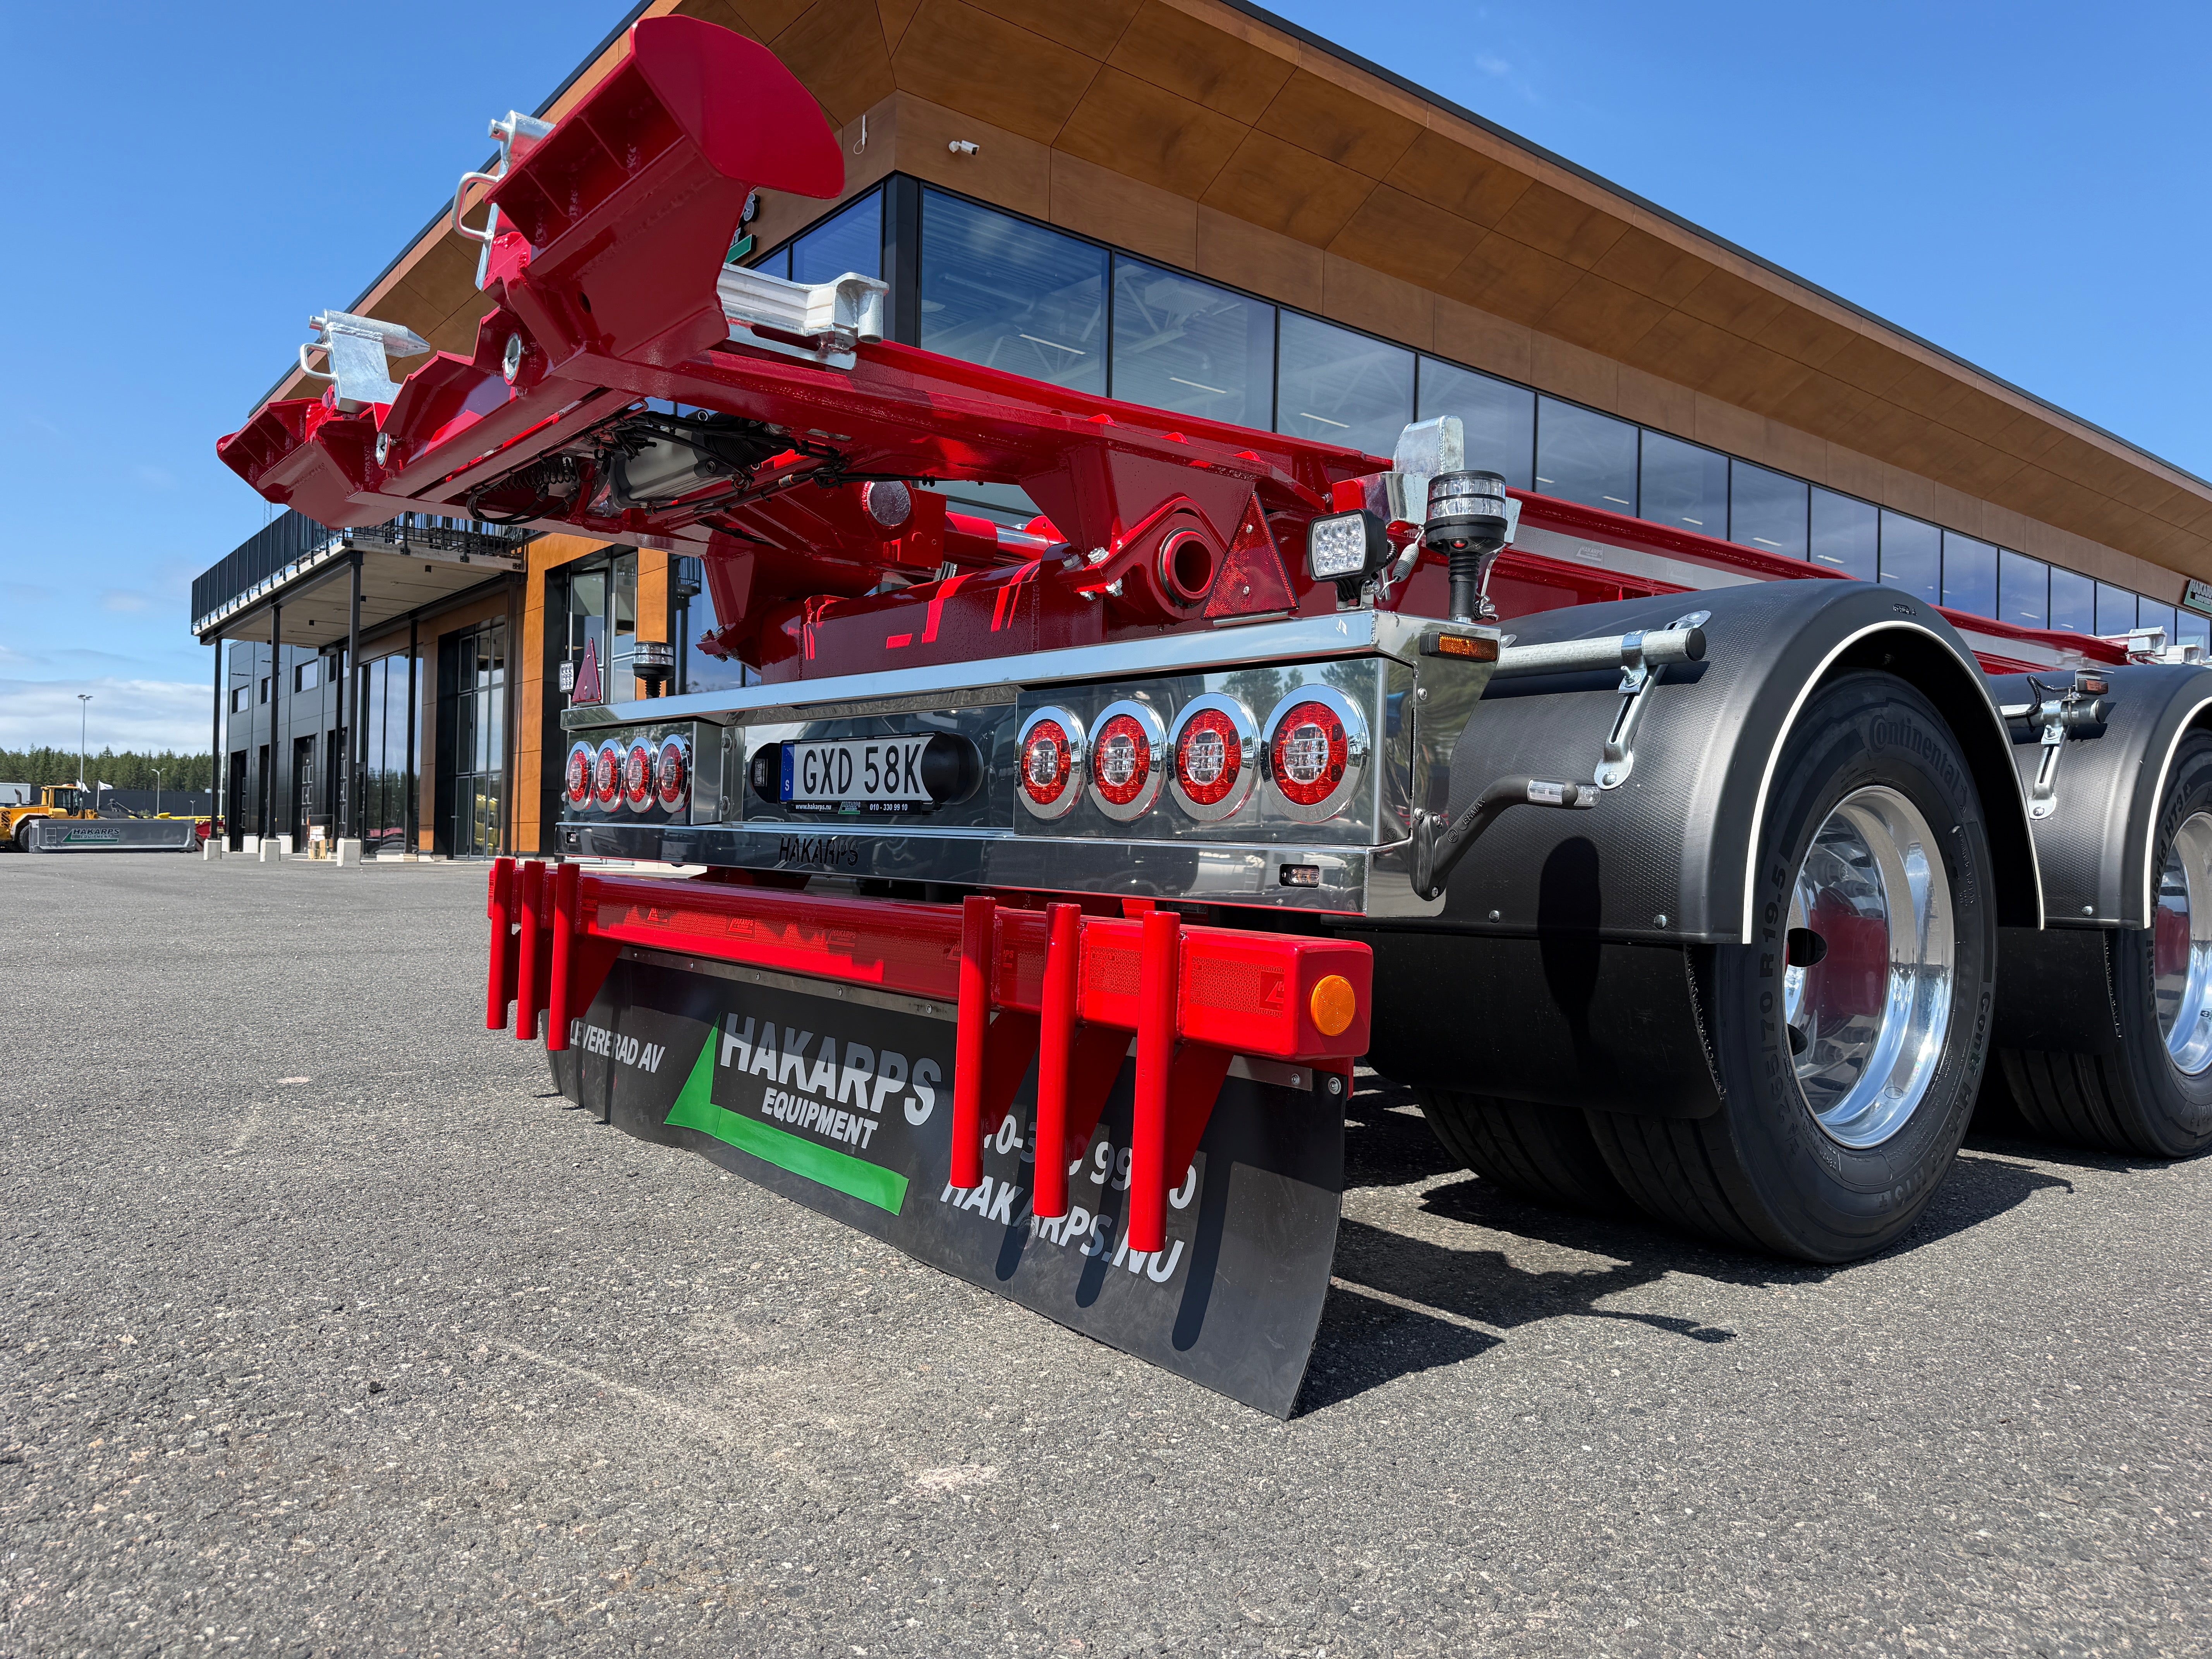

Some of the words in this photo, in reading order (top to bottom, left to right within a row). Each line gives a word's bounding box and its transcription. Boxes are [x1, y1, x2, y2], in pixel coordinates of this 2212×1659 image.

[785, 779, 790, 791] S
[803, 748, 852, 794] GXD
[864, 744, 921, 794] 58K
[1869, 715, 1960, 793] Continental
[779, 837, 859, 866] HAKARPS
[570, 1019, 639, 1065] LEVERERAD
[637, 1042, 666, 1073] AV
[1968, 991, 1990, 1075] Conti
[720, 1012, 942, 1126] HAKARPS
[761, 1087, 879, 1149] EQUIPMENT
[1930, 1082, 1972, 1175] Hybrid
